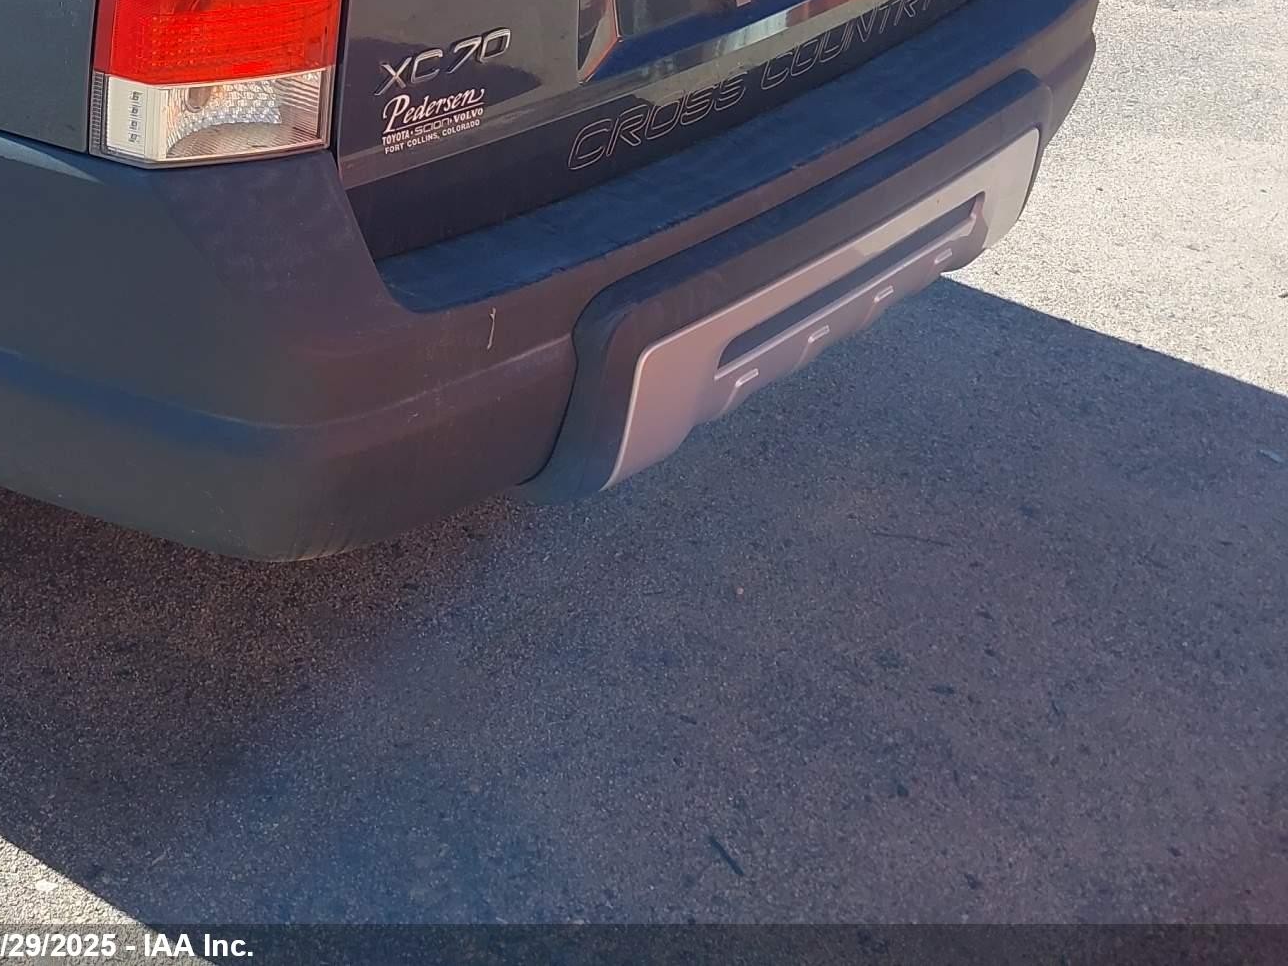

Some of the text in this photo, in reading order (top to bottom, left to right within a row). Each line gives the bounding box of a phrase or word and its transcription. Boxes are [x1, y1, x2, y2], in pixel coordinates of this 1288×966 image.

[382, 89, 485, 134] Pedersen
[382, 130, 410, 146] TOYOTA
[453, 108, 484, 123] VOLVO
[568, 72, 748, 171] CROSS
[385, 119, 480, 154] FORT COLLINS, COLORADO
